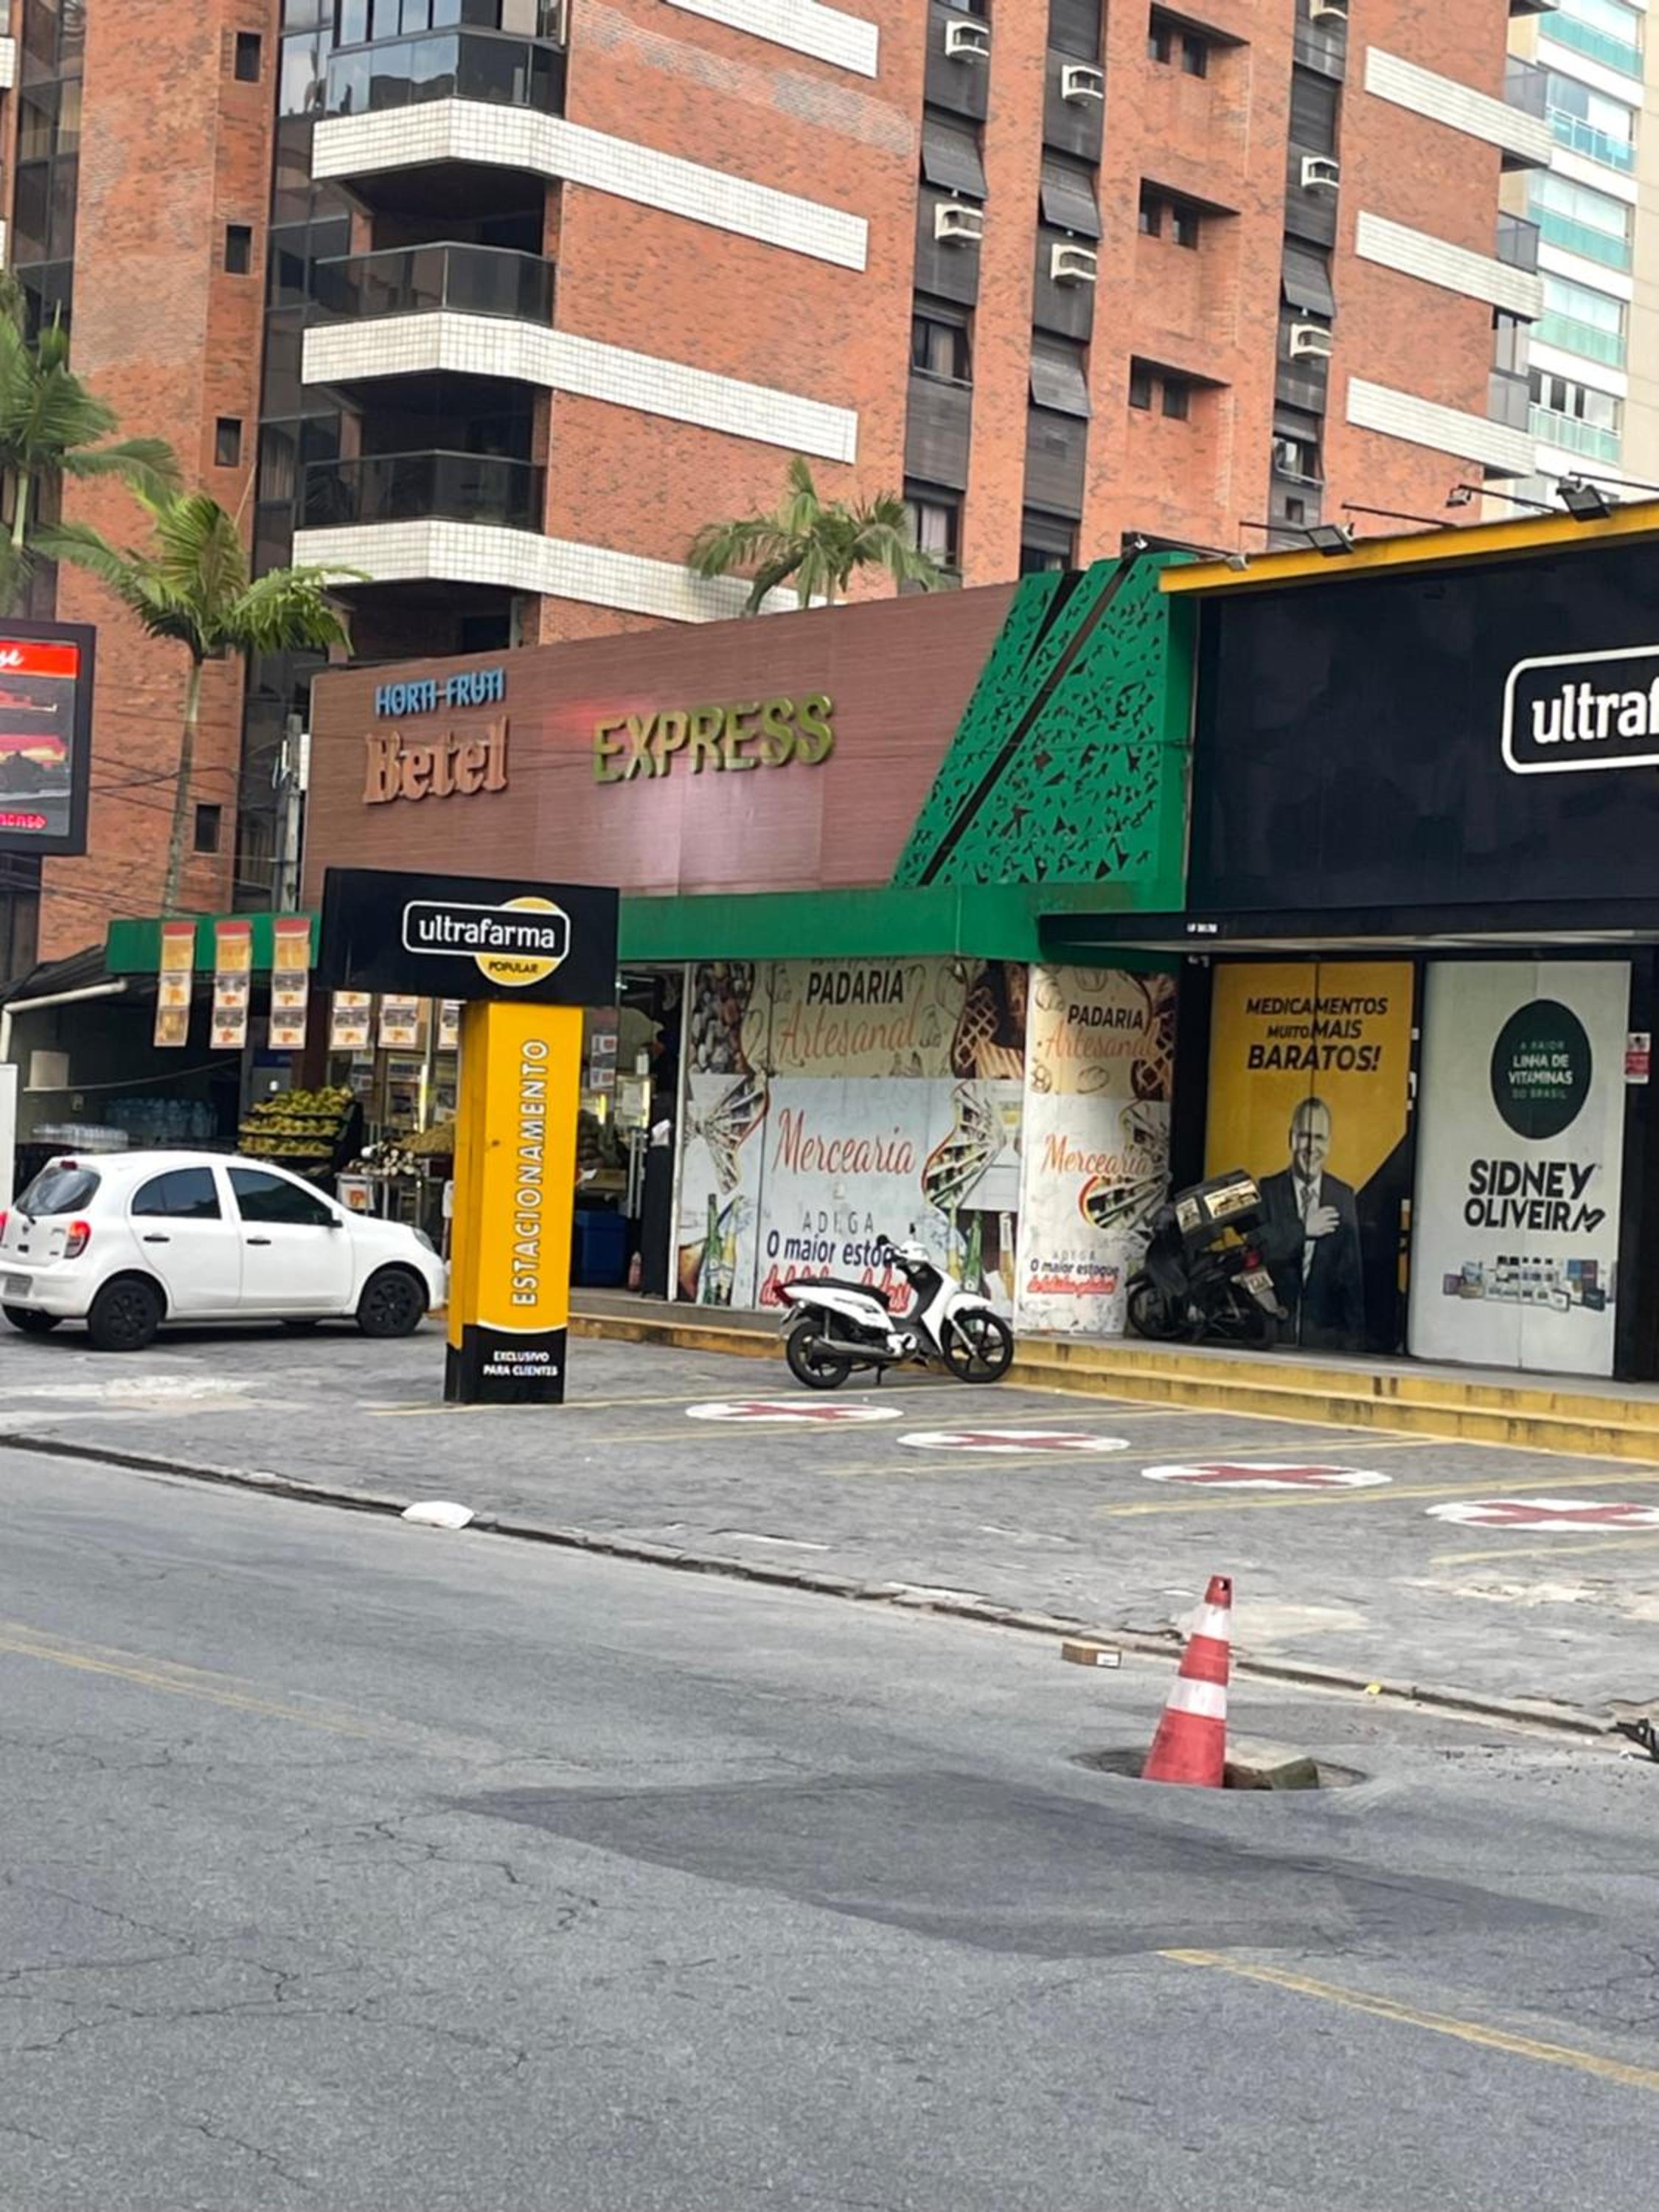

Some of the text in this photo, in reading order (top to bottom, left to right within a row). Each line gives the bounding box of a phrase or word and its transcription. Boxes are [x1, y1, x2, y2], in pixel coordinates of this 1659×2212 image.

[594, 694, 835, 784] EXPRESS
[364, 715, 509, 804] Betel
[419, 914, 555, 949] ultrafarma
[488, 961, 538, 973] POPULAR
[806, 969, 904, 1006] PADARIA
[1068, 1004, 1143, 1030] PADARIA
[1246, 997, 1388, 1015] MEDICAMENTOS
[779, 987, 923, 1064] Artesanal
[1045, 1016, 1160, 1060] Artesanal
[1267, 1018, 1363, 1039] MUITO MAIS
[1248, 1043, 1382, 1072] BARATOS!
[1513, 1054, 1569, 1068] LINHA DE
[1509, 1071, 1573, 1085] VITAMINAS
[772, 1107, 915, 1175] Mercearia
[1040, 1133, 1150, 1175] Mercearia
[511, 1039, 549, 1307] ESTACIONAMENTO
[1469, 1159, 1596, 1200] SIDNEY
[767, 1229, 780, 1258] O
[784, 1234, 837, 1263] maior
[1030, 1258, 1039, 1272] O
[1041, 1262, 1074, 1274] maior
[483, 1364, 558, 1377] PARA CLIENTES
[493, 1350, 550, 1363] EXCLUSIVO
